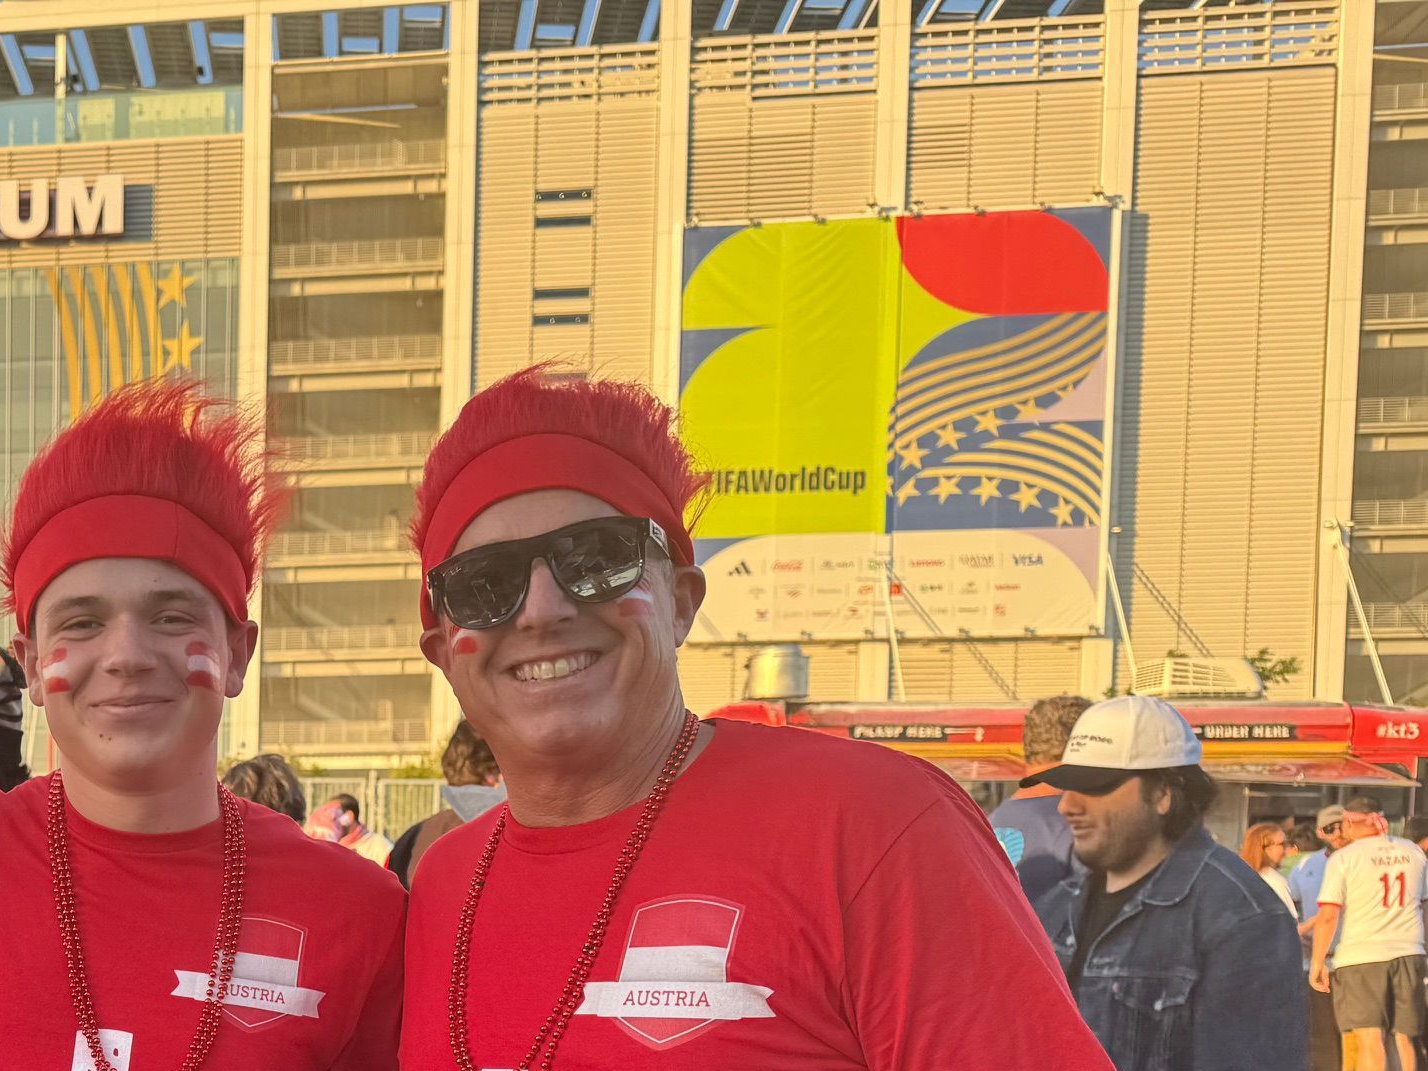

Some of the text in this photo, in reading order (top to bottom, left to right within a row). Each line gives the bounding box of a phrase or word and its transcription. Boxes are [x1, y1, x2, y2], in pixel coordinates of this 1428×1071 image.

[715, 466, 867, 496] IFAWorldCup
[1252, 725, 1290, 738] HERE
[1376, 721, 1420, 740] #kt3
[1379, 871, 1406, 908] 11
[622, 989, 711, 1008] AUSTRIA
